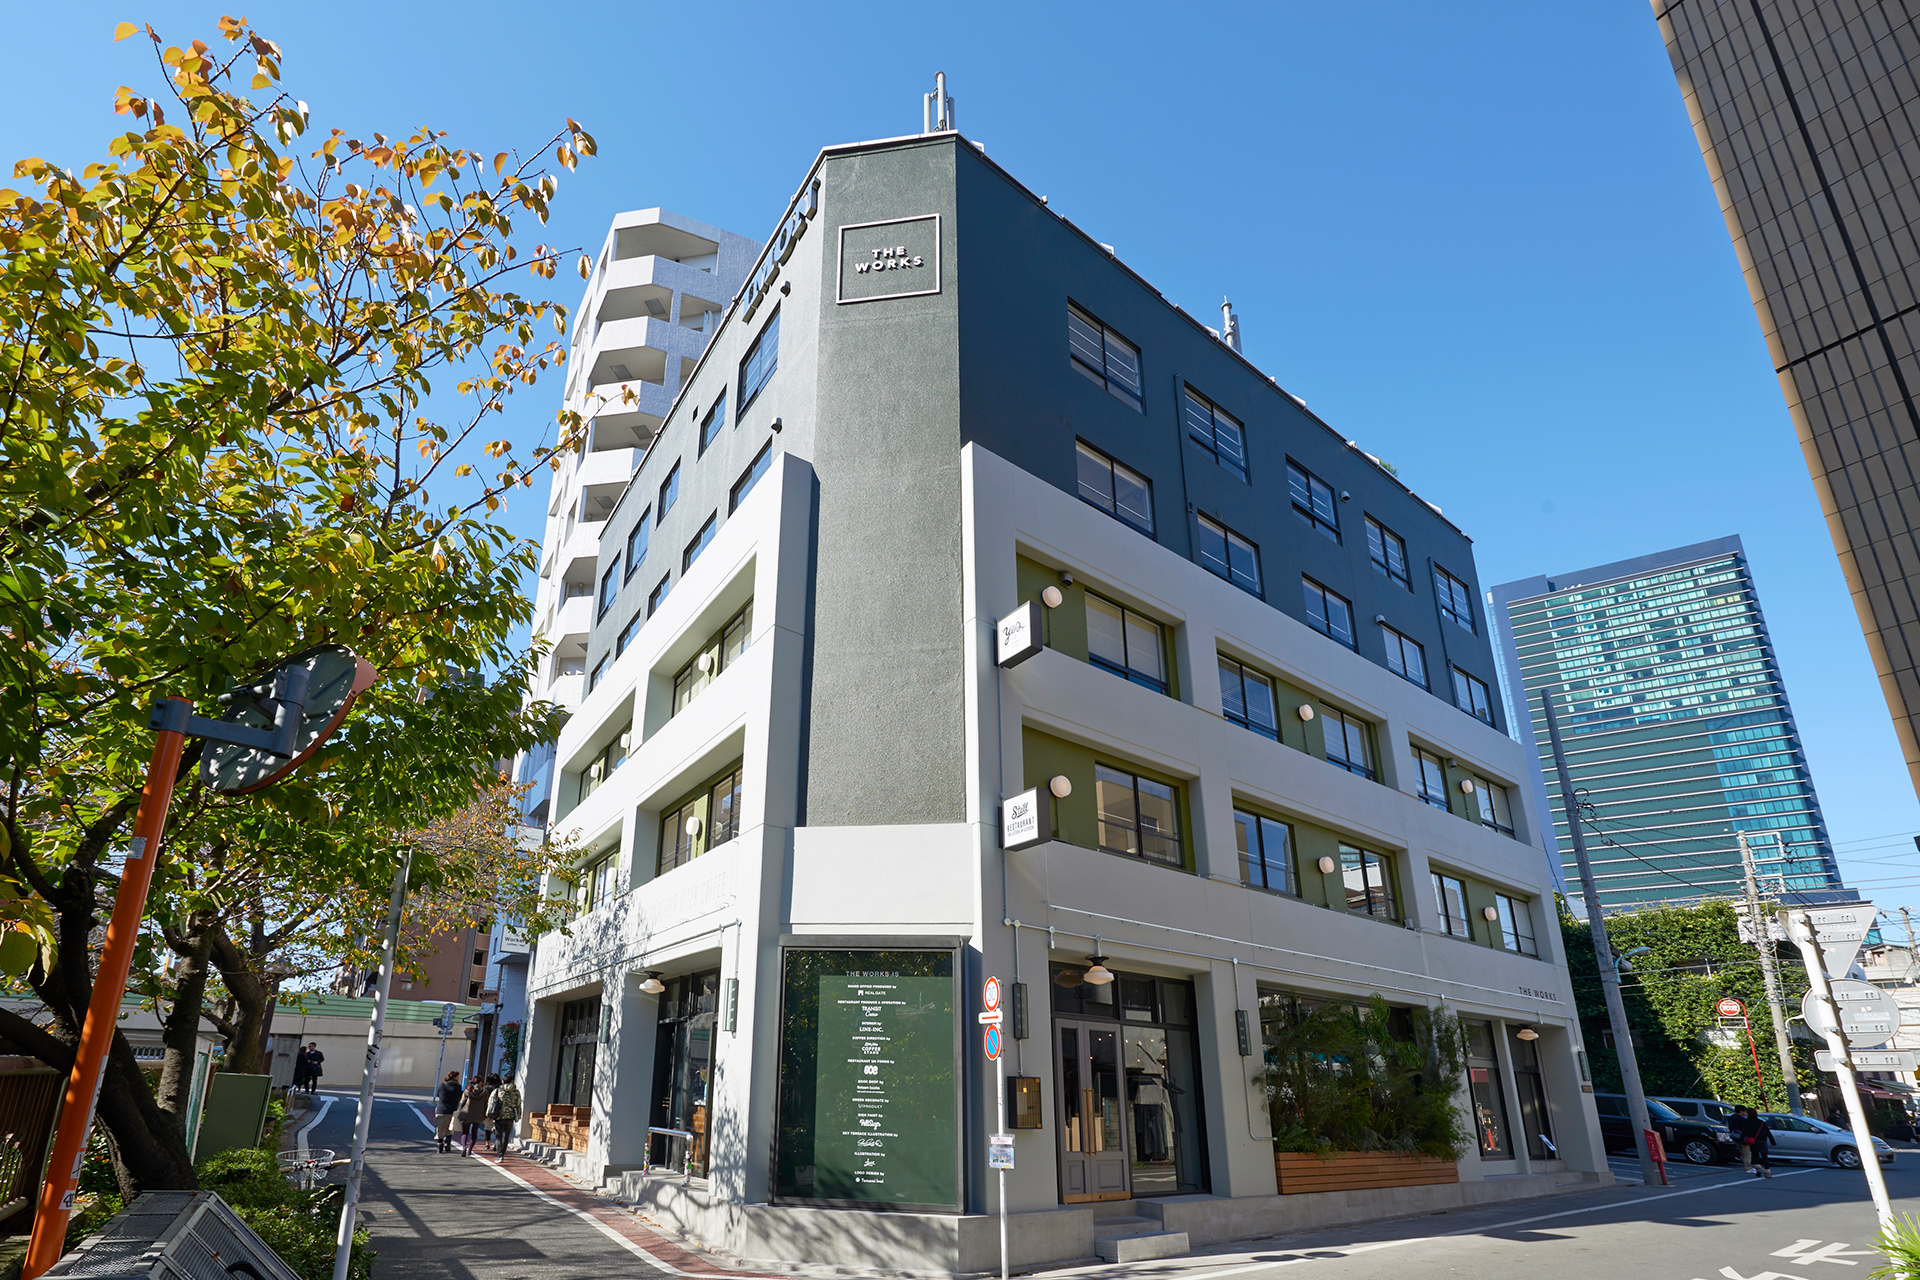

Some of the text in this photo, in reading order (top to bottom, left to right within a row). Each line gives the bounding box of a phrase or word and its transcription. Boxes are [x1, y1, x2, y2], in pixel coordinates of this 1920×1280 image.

[872, 246, 905, 258] THE
[855, 255, 922, 272] WORKS
[1007, 816, 1035, 832] RESTAURANT
[988, 986, 996, 1002] 30
[1519, 986, 1556, 1001] THE WORKS
